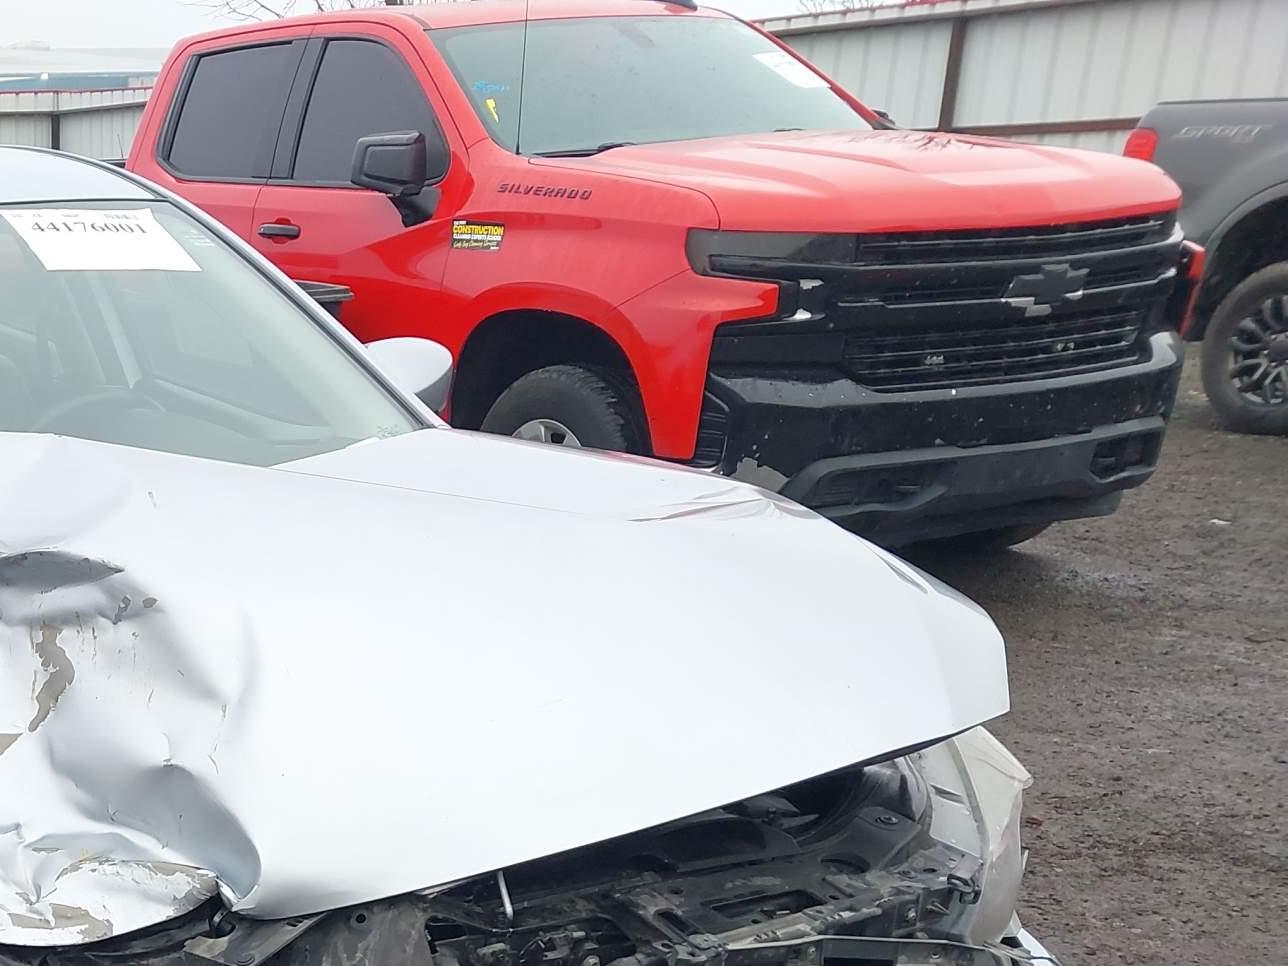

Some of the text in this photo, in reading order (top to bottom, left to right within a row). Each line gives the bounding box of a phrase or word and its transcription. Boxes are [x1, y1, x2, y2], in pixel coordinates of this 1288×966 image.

[497, 183, 593, 201] SILVERADO
[31, 221, 148, 234] 44176001
[452, 224, 505, 236] CONSTRUCTION
